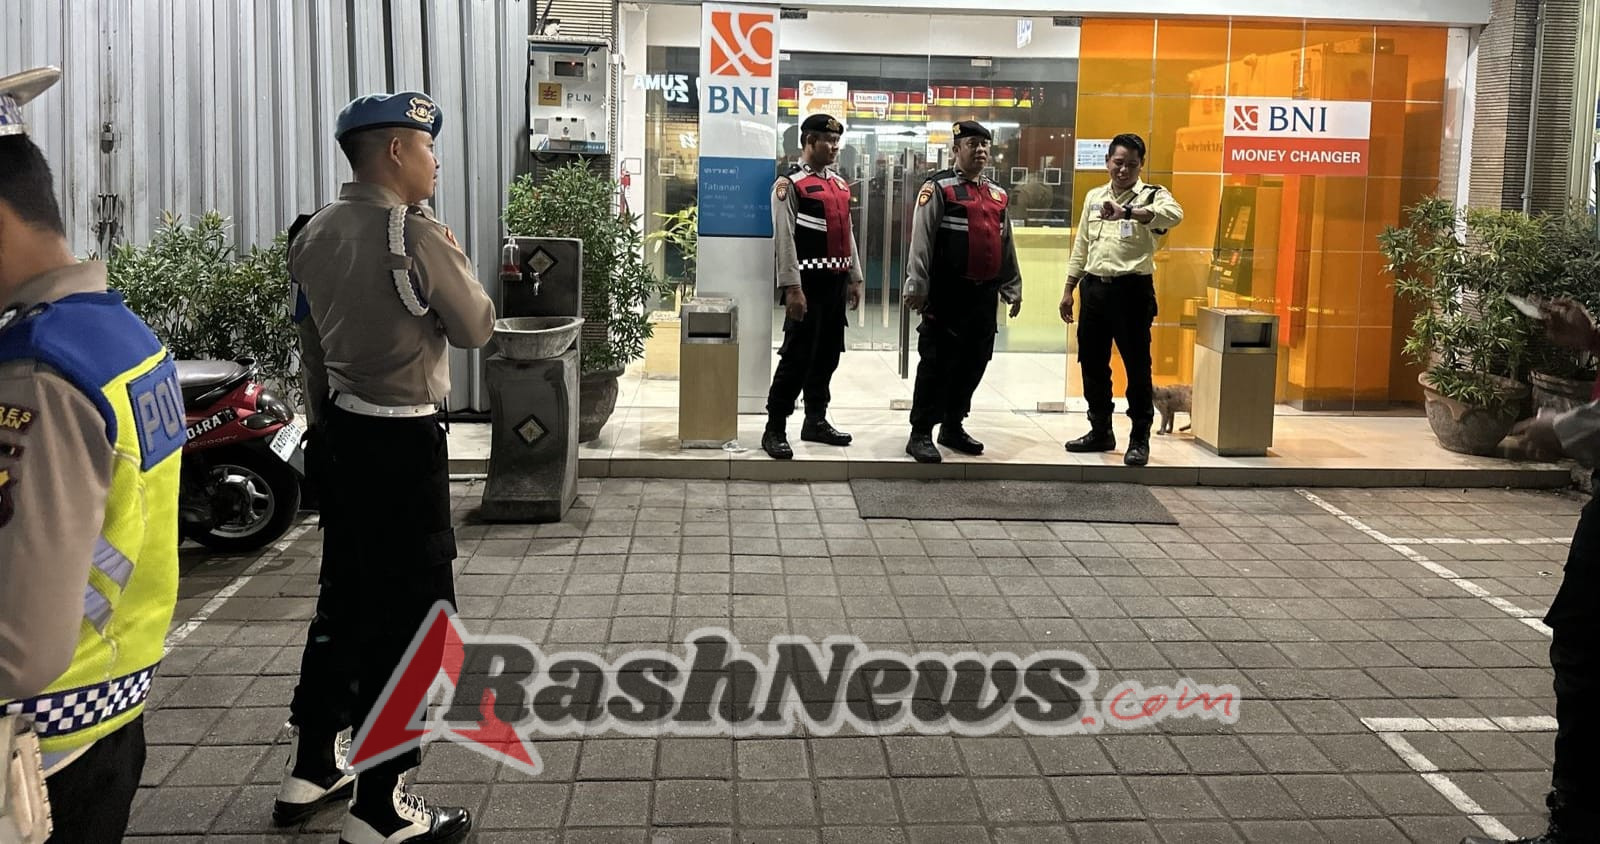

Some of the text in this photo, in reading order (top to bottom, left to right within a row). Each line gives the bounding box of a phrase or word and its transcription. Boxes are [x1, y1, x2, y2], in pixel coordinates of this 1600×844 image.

[567, 92, 592, 102] PLN
[708, 85, 769, 115] BNI
[1269, 105, 1328, 133] BNI
[1231, 149, 1361, 164] MONEY CHANGER
